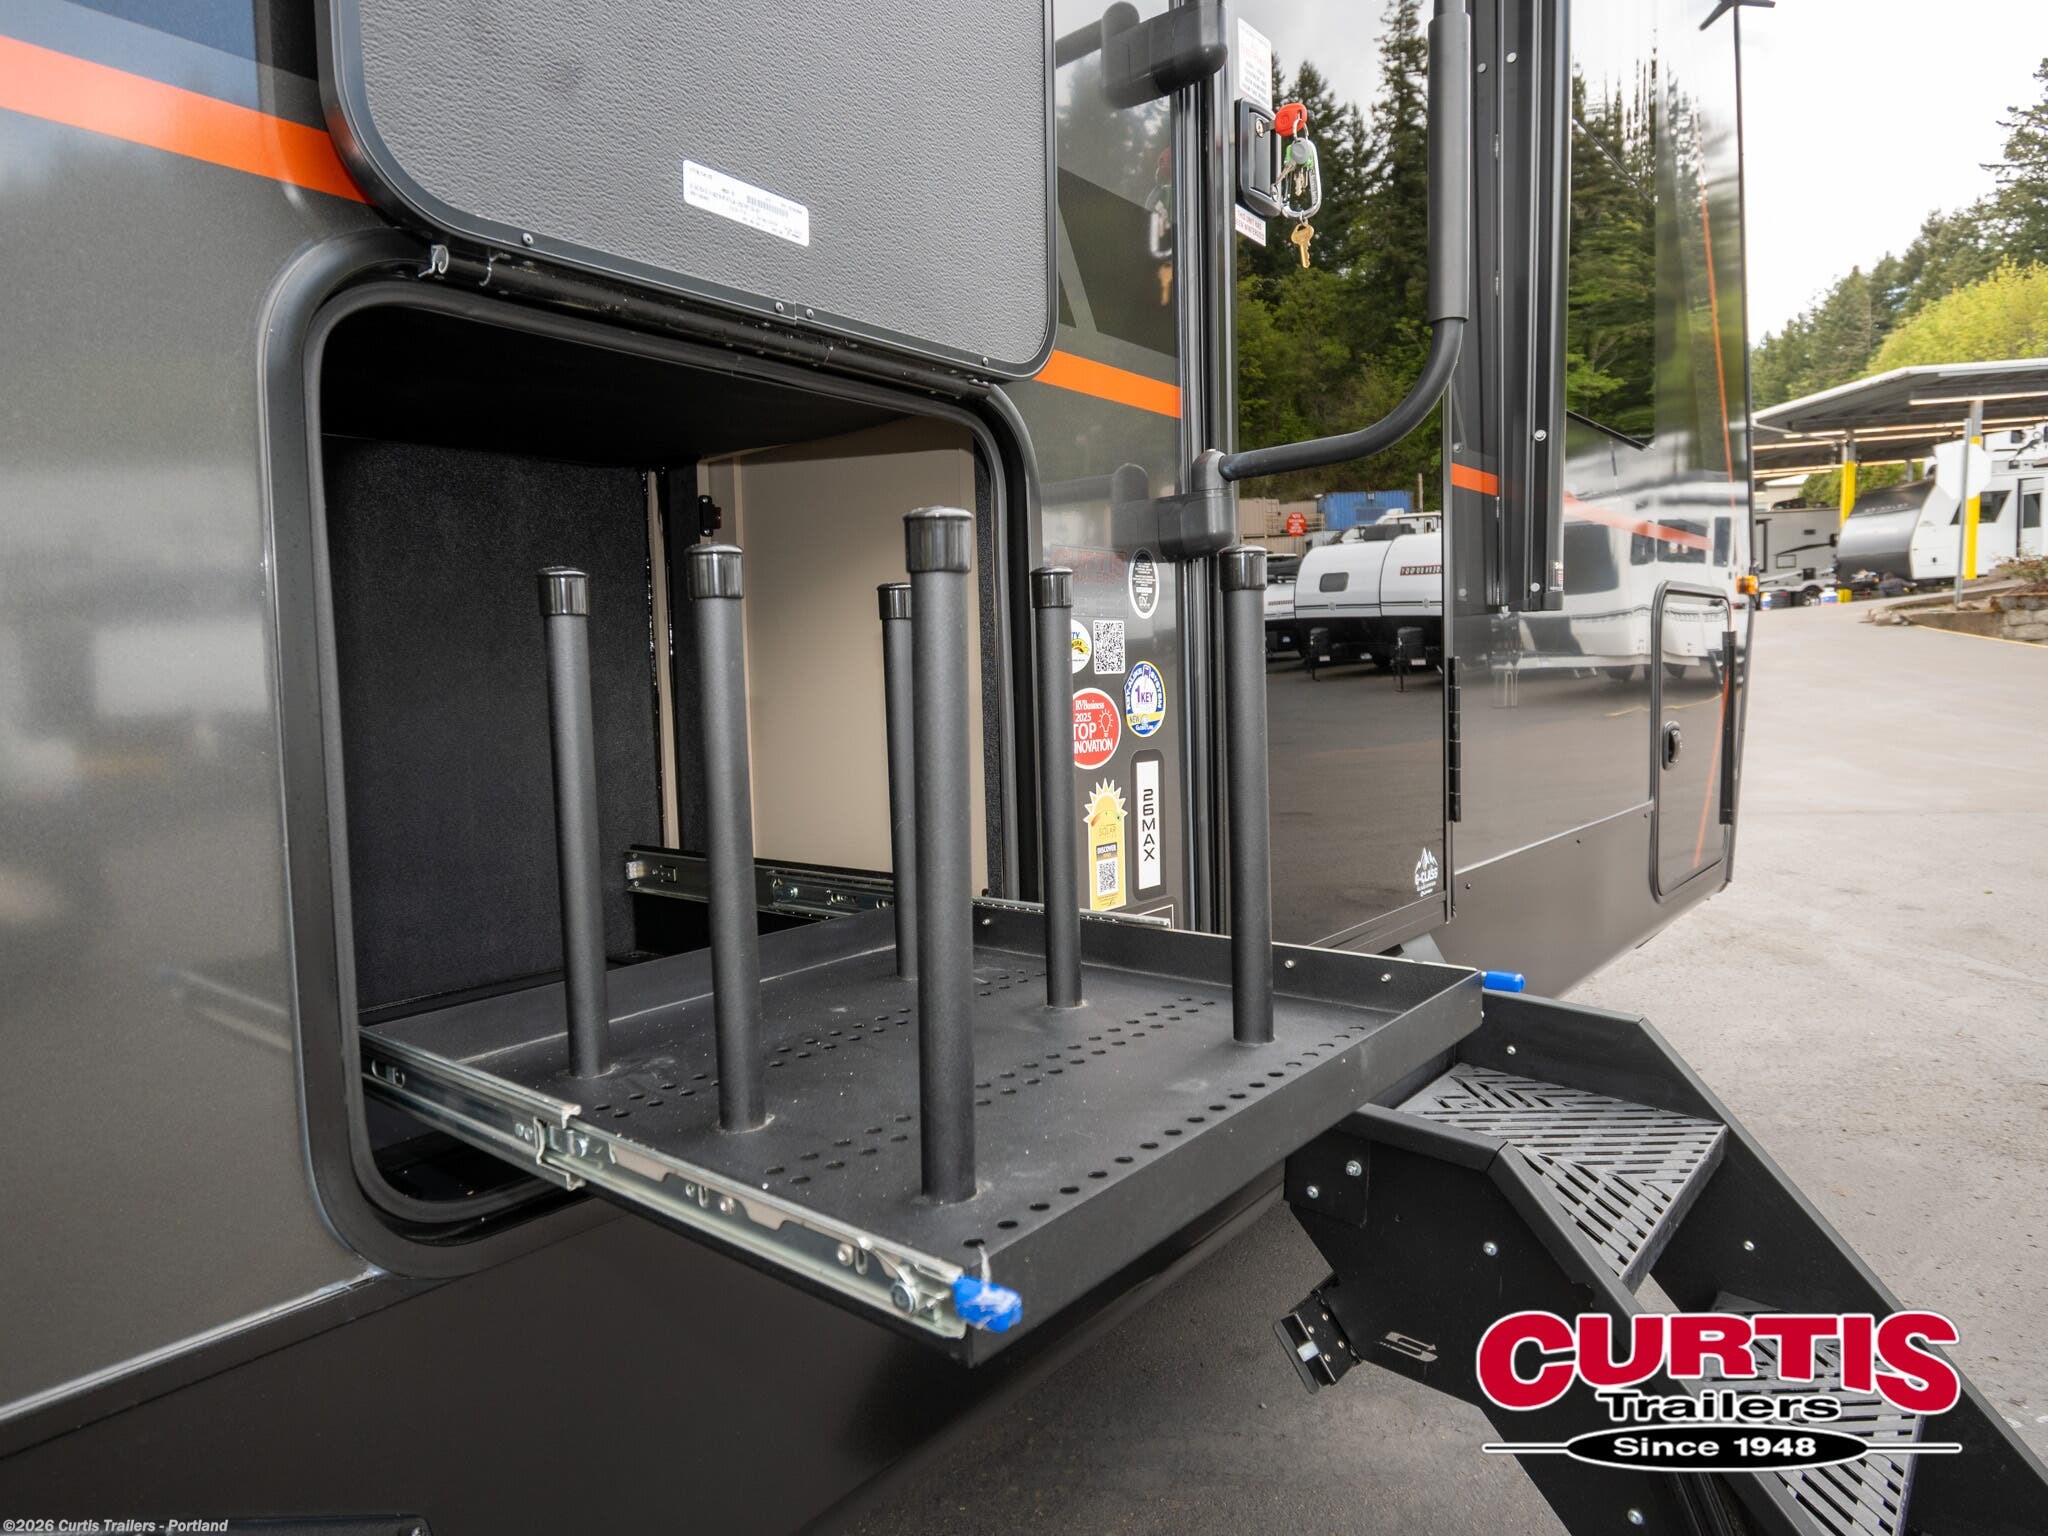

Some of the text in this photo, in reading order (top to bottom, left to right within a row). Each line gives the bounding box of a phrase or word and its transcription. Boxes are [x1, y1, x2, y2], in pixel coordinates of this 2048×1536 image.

[1054, 548, 1125, 577] CURTIS
[1073, 570, 1115, 585] RAILERS
[1075, 711, 1091, 723] 2025
[1073, 722, 1097, 741] TOP
[1074, 738, 1113, 755] NOVATION
[1142, 788, 1156, 862] 26MAX
